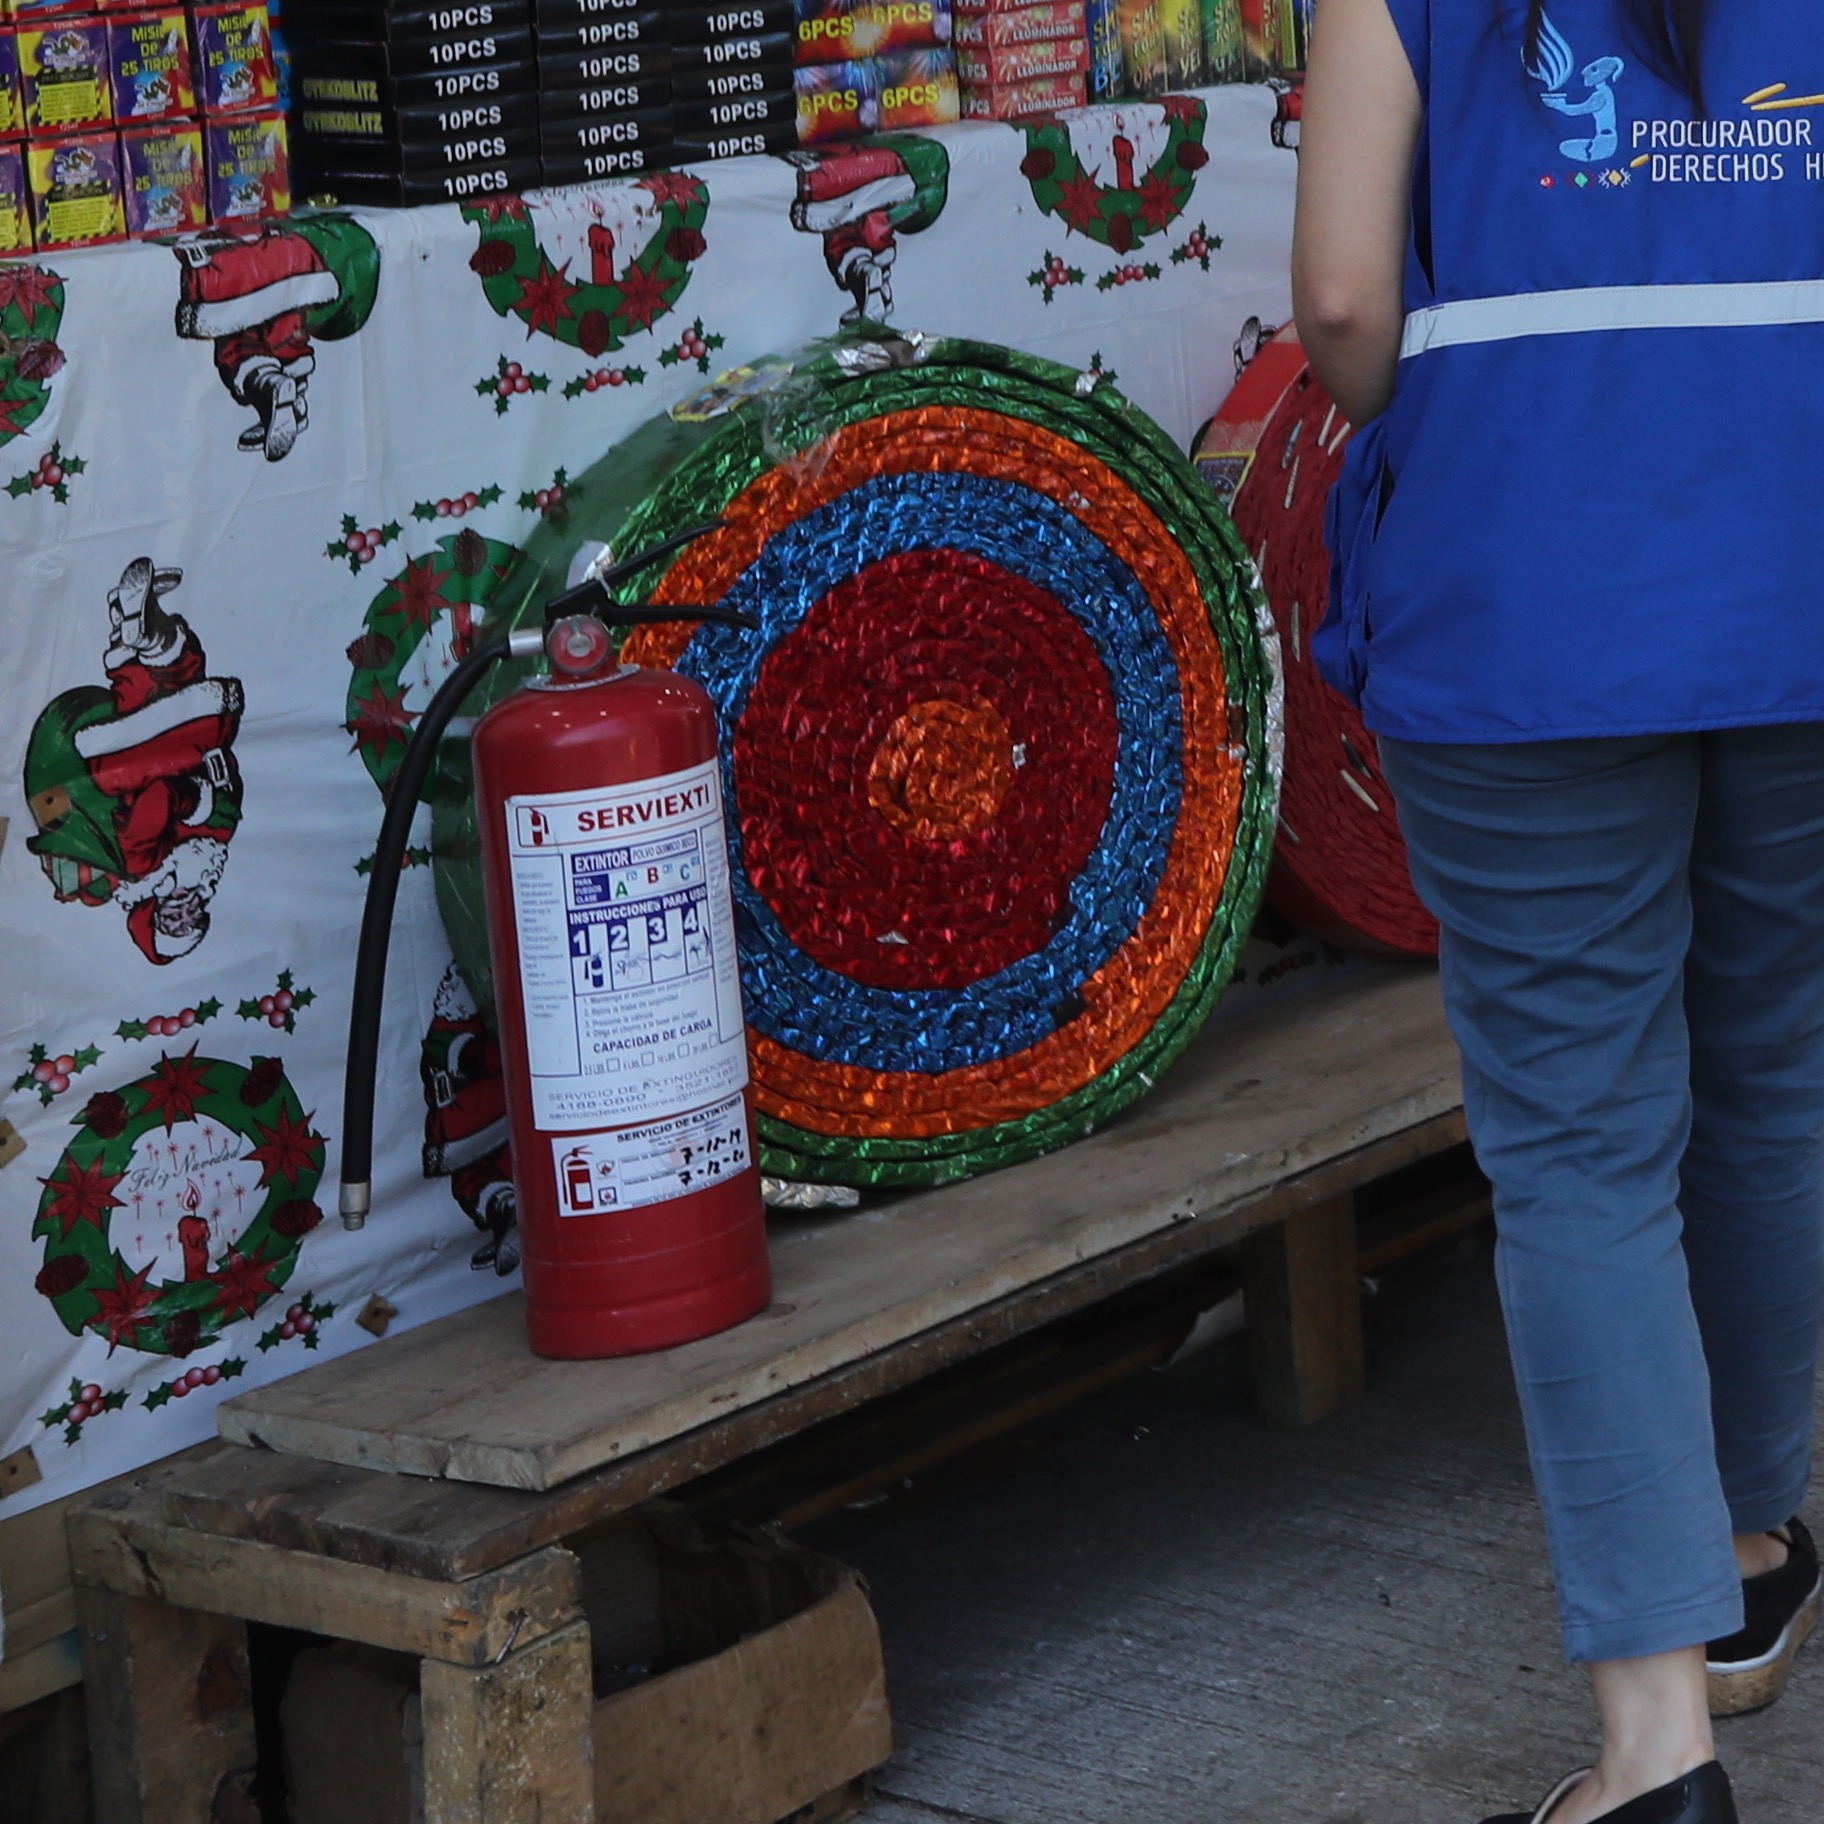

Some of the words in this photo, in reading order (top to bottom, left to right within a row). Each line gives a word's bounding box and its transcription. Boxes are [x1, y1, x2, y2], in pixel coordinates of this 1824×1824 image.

[429, 5, 492, 30] 10PCS
[707, 10, 764, 32] 10PCS
[872, 1, 934, 25] 6PCS
[579, 21, 639, 44] 10PCS
[798, 15, 855, 42] 6PCS
[430, 38, 496, 63] 10PCS
[704, 40, 761, 62] 10PCS
[580, 54, 640, 77] 10PCS
[435, 72, 499, 96] 10PCS
[708, 73, 763, 94] 10PCS
[580, 87, 638, 110] 10PCS
[798, 90, 859, 118] 6PCS
[881, 83, 941, 110] 6PCS
[439, 106, 501, 130] 10PCS
[711, 100, 767, 123] 10PCS
[578, 122, 638, 146] 10PCS
[708, 135, 765, 157] 10PCS
[1631, 118, 1812, 149] PROCURADOR
[444, 137, 506, 162] 10PCS
[584, 151, 643, 175] 10PCS
[1651, 151, 1784, 184] DERECHOS
[445, 171, 508, 195] 10PCS
[577, 783, 710, 833] SERVIEXTI
[574, 849, 629, 874] EXTINTOR
[615, 880, 629, 899] A
[647, 866, 660, 885] B
[680, 863, 691, 882] C
[569, 895, 662, 926] INSTRUCCIONES
[662, 890, 689, 910] PARA
[689, 885, 707, 902] USO
[573, 929, 588, 955] 1
[610, 924, 629, 950] 2
[649, 917, 666, 942] 3
[683, 906, 699, 932] 4
[593, 1028, 660, 1055] CAPACIDAD
[662, 1026, 678, 1041] DE
[680, 1016, 713, 1038] CARGA
[616, 1122, 673, 1144] SERVICIO
[674, 1118, 691, 1130] DE
